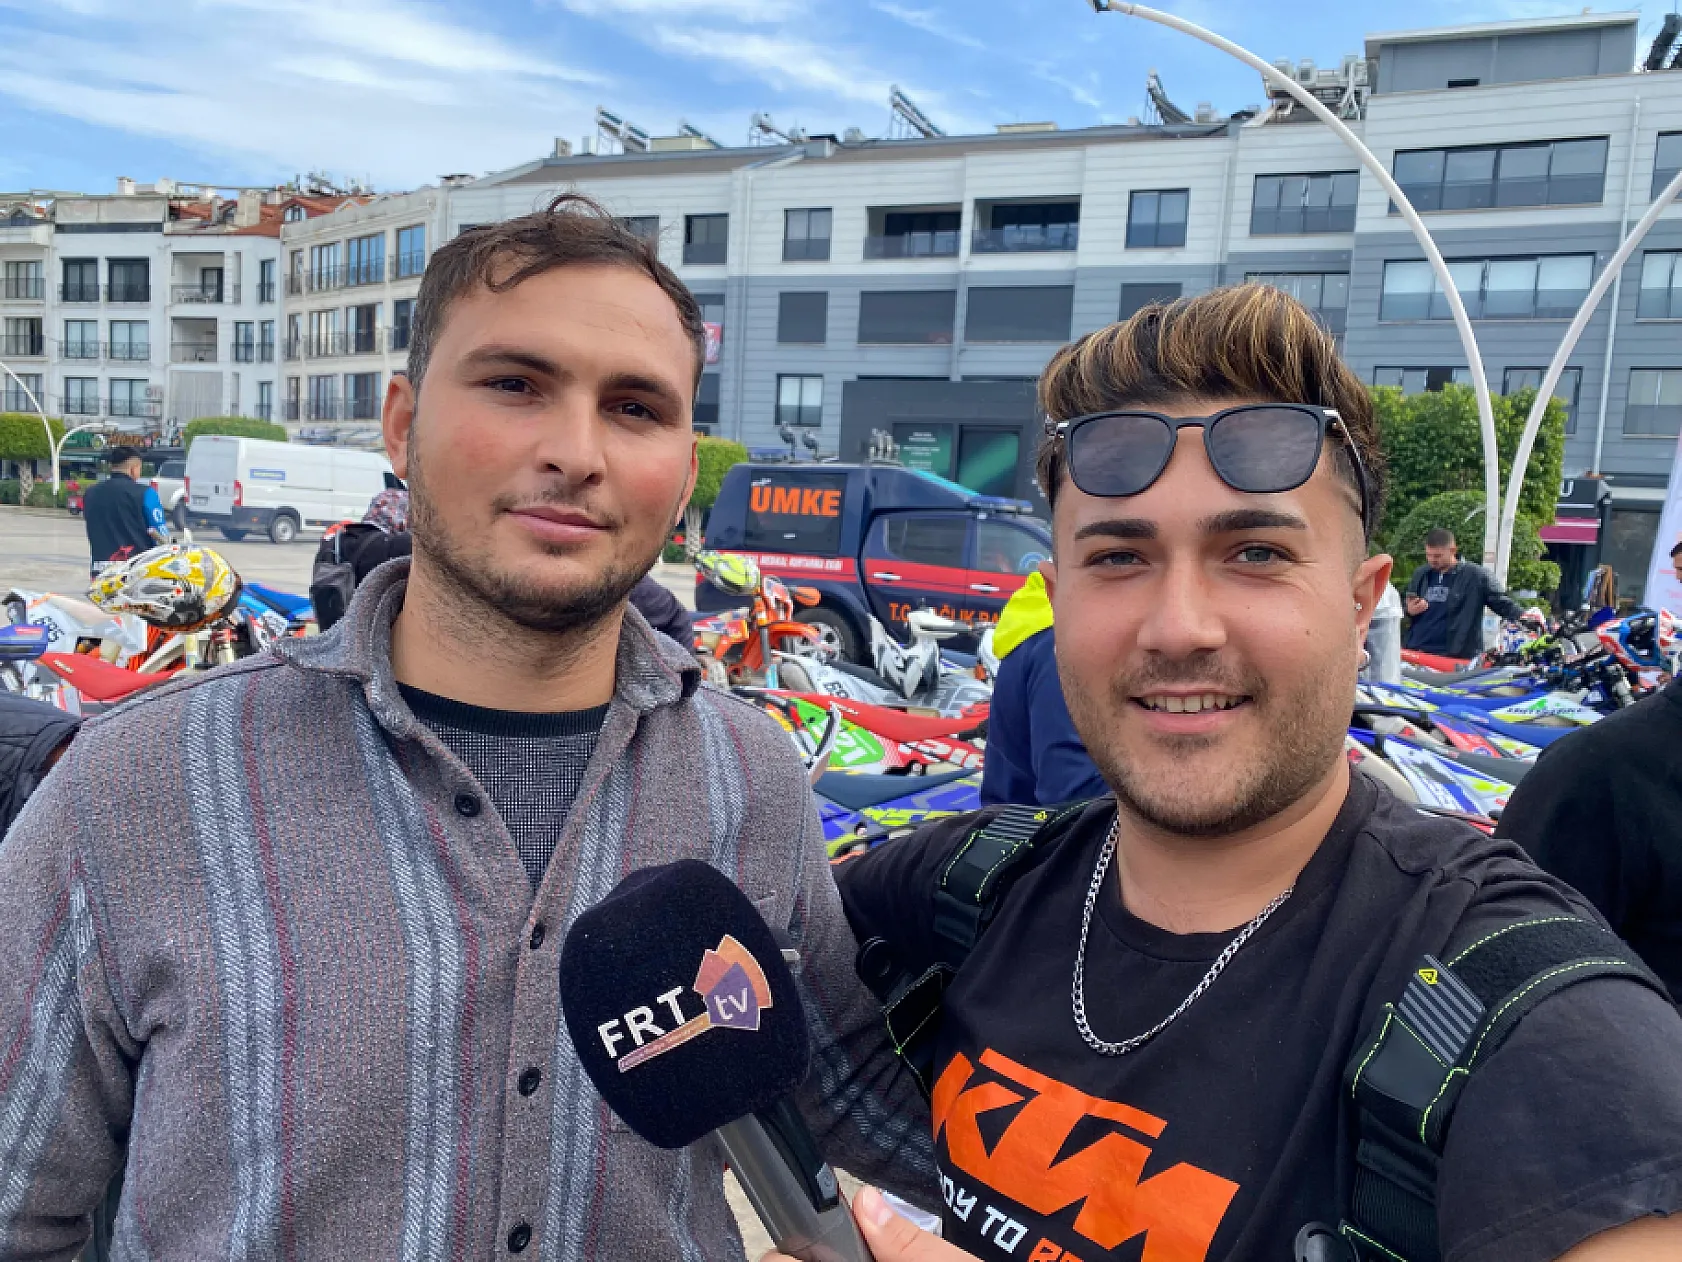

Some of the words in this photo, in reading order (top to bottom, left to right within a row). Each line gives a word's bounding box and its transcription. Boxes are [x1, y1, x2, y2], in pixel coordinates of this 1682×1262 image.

[597, 985, 686, 1058] FRT
[713, 987, 748, 1020] tv
[933, 1048, 1240, 1262] KTM
[980, 1205, 1029, 1254] TO
